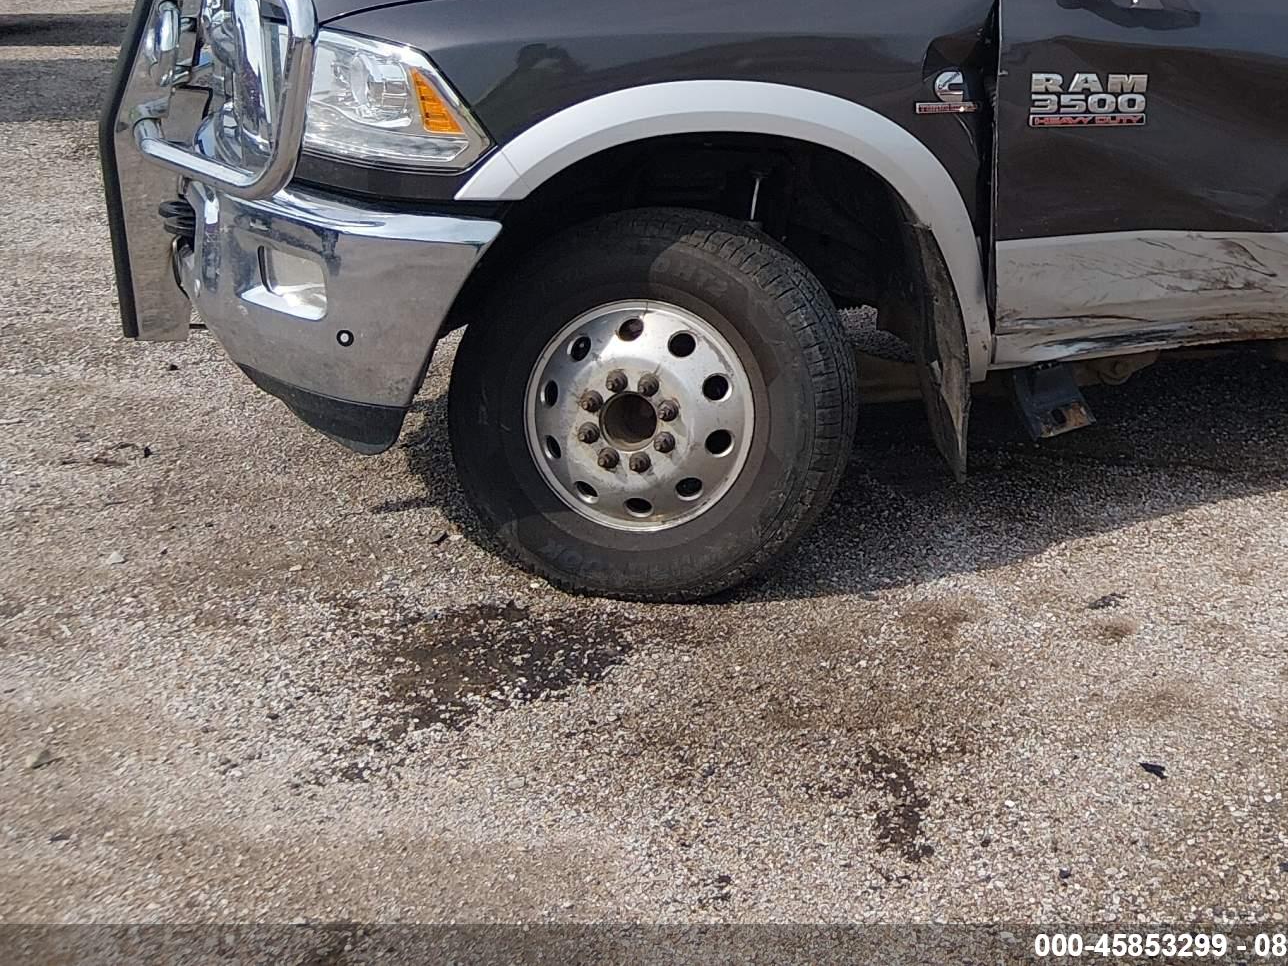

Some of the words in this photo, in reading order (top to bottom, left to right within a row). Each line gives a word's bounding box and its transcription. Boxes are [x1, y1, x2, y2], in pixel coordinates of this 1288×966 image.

[1030, 72, 1149, 93] RAM
[1029, 93, 1147, 113] 3500
[1034, 116, 1089, 125] HEAVY
[1095, 115, 1142, 125] DUTY
